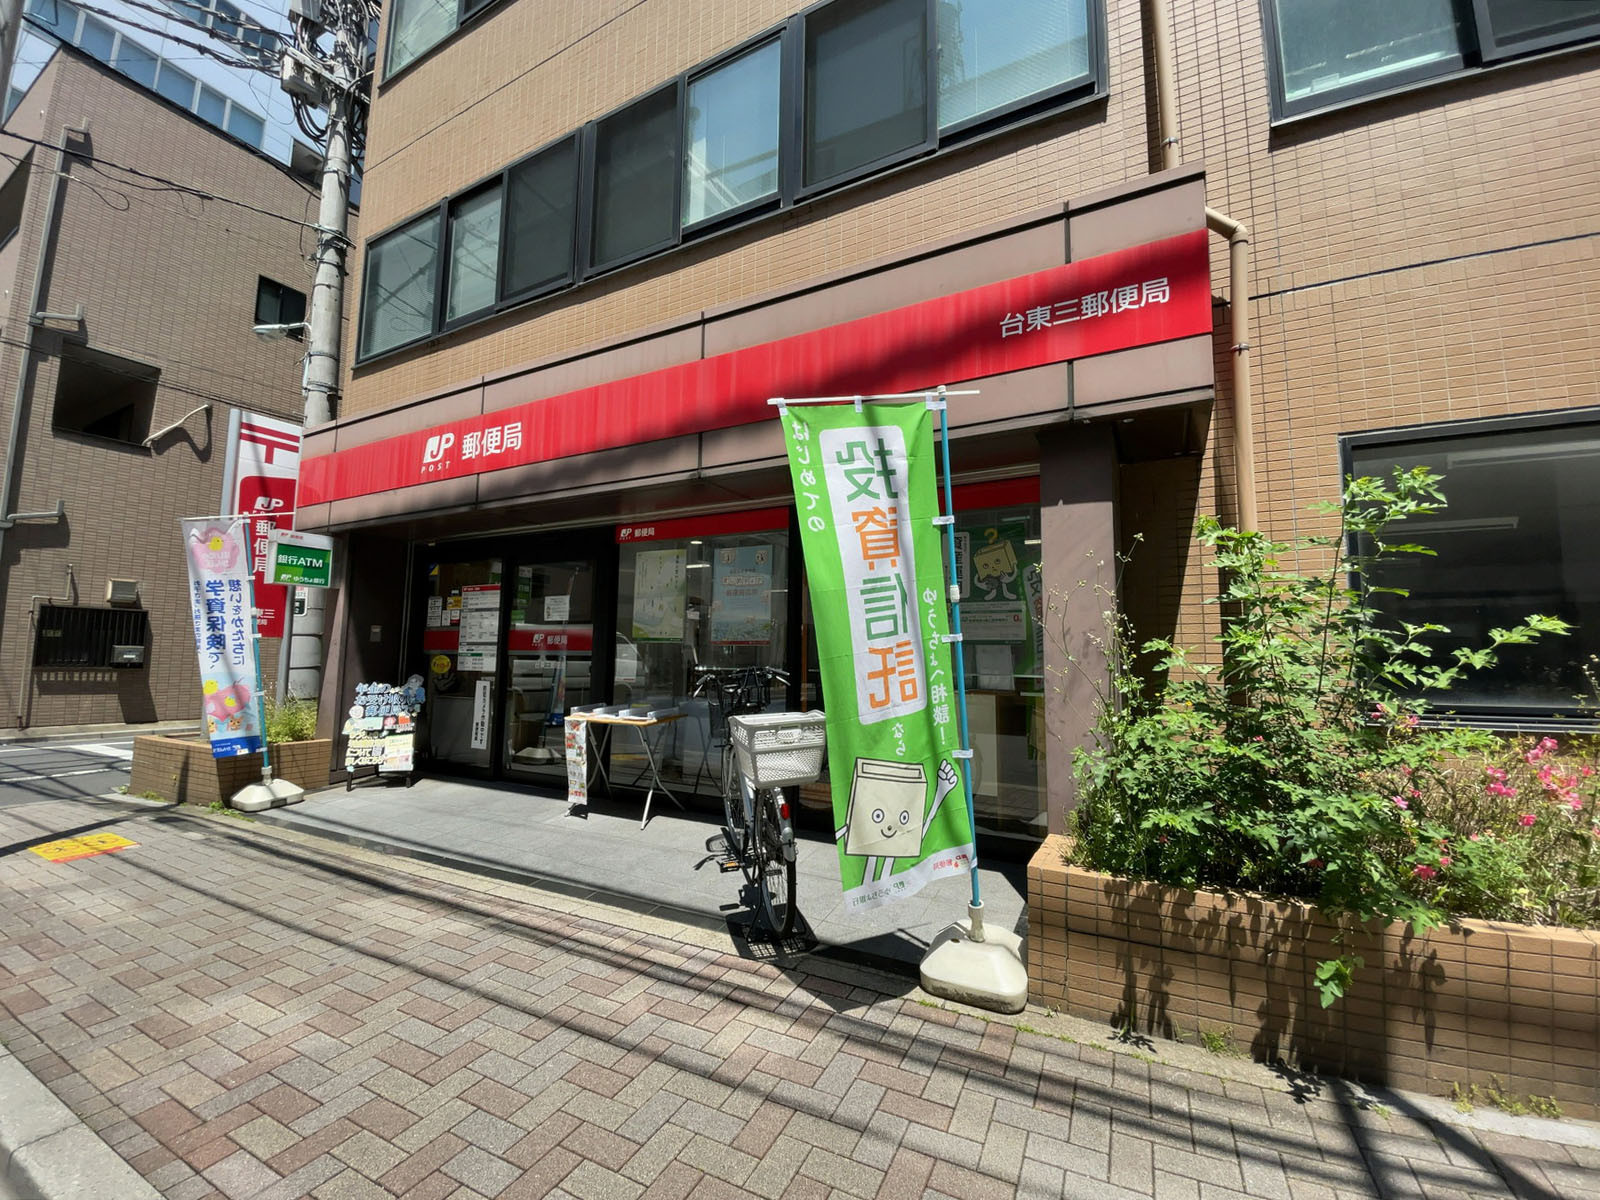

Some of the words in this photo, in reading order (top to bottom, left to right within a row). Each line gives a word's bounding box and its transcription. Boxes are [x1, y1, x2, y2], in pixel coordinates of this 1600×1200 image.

[999, 277, 1170, 338] 台東三郵便局
[423, 433, 455, 464] JP
[462, 422, 522, 460] 郵便局
[420, 461, 451, 474] POST
[277, 554, 323, 568] 銀行ATM
[293, 576, 325, 584] ゆうちょ銀行
